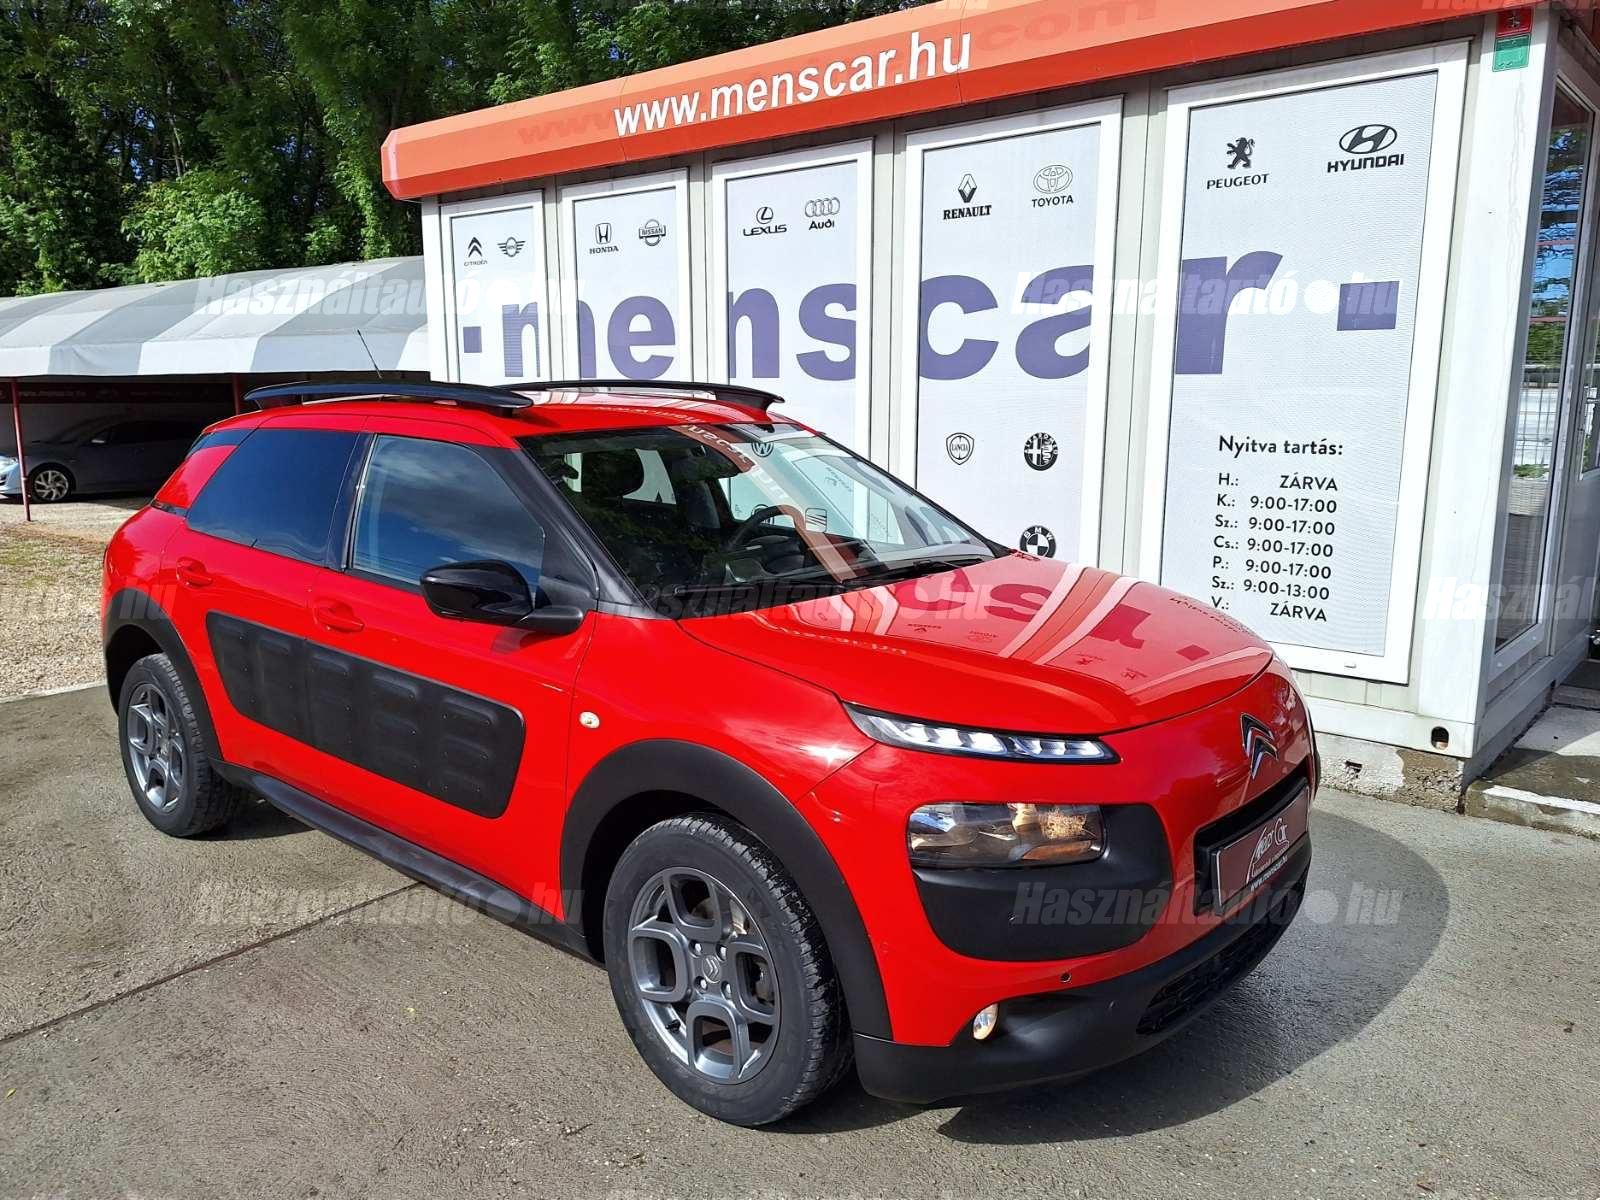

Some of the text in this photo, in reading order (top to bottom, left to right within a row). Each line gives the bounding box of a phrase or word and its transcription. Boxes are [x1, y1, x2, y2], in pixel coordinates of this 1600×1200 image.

[613, 31, 971, 137] www.menscar.hu
[1327, 153, 1405, 173] HYUNDAI
[1206, 173, 1270, 189] PEUGEOT
[1031, 195, 1074, 208] TOYOTA
[943, 204, 992, 220] RENAULT
[743, 224, 787, 236] LEXUS
[808, 219, 835, 230] Audi
[589, 245, 619, 254] HONDA
[1218, 435, 1343, 458] Nyitva tartás:
[1218, 472, 1338, 491] H.: ZÁRVA
[1217, 493, 1337, 513] K.: 9:00-17:00
[1215, 514, 1335, 535] Sz.: 9:00-17:00
[1213, 536, 1333, 557] Cs.: 9:00-17:00
[1213, 556, 1331, 579] P.: 9:00-17:00
[1211, 576, 1330, 600] Sz.: 9:00-13:00
[1211, 596, 1229, 610] V.:
[1270, 602, 1327, 622] ZÁRVA
